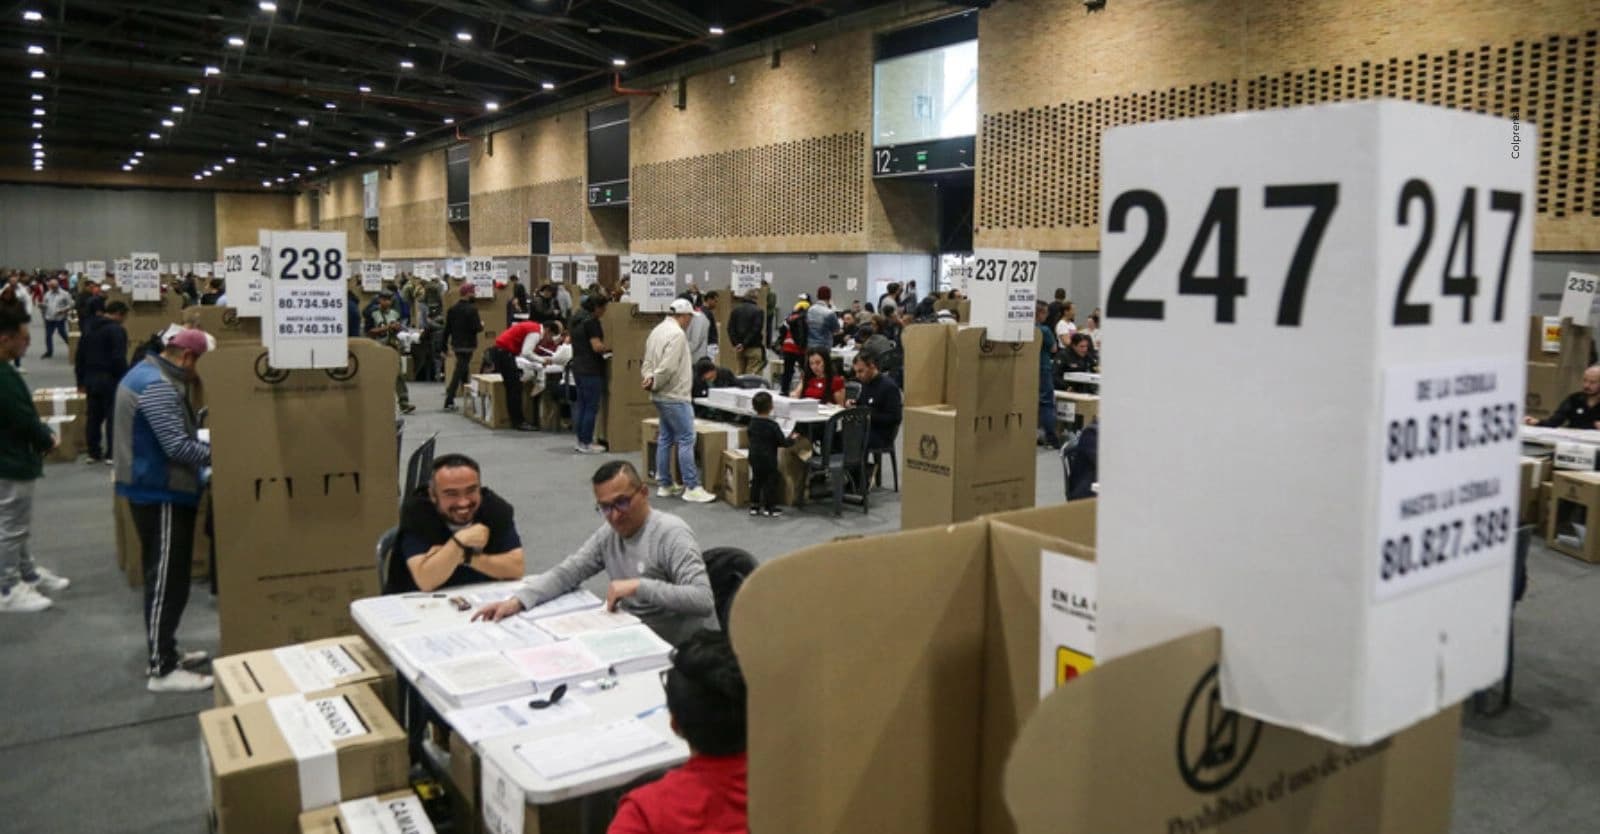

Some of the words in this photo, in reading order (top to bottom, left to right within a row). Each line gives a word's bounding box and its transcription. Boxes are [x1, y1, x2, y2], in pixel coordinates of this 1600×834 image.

[875, 150, 891, 173] 12
[279, 247, 343, 280] 238
[1106, 183, 1340, 327] 247
[1393, 178, 1524, 327] 247
[134, 258, 159, 271] 220
[472, 260, 492, 271] 219
[631, 259, 649, 275] 228
[650, 260, 674, 275] 228
[975, 258, 1008, 281] 237
[1011, 260, 1037, 283] 237
[1568, 277, 1595, 293] 235
[278, 298, 343, 309] 80.734.945
[278, 324, 343, 334] 80.740.316
[1388, 402, 1517, 463] 80.816.353
[1380, 505, 1511, 582] 80.827.389
[1052, 588, 1068, 602] EN
[1072, 595, 1087, 609] LA
